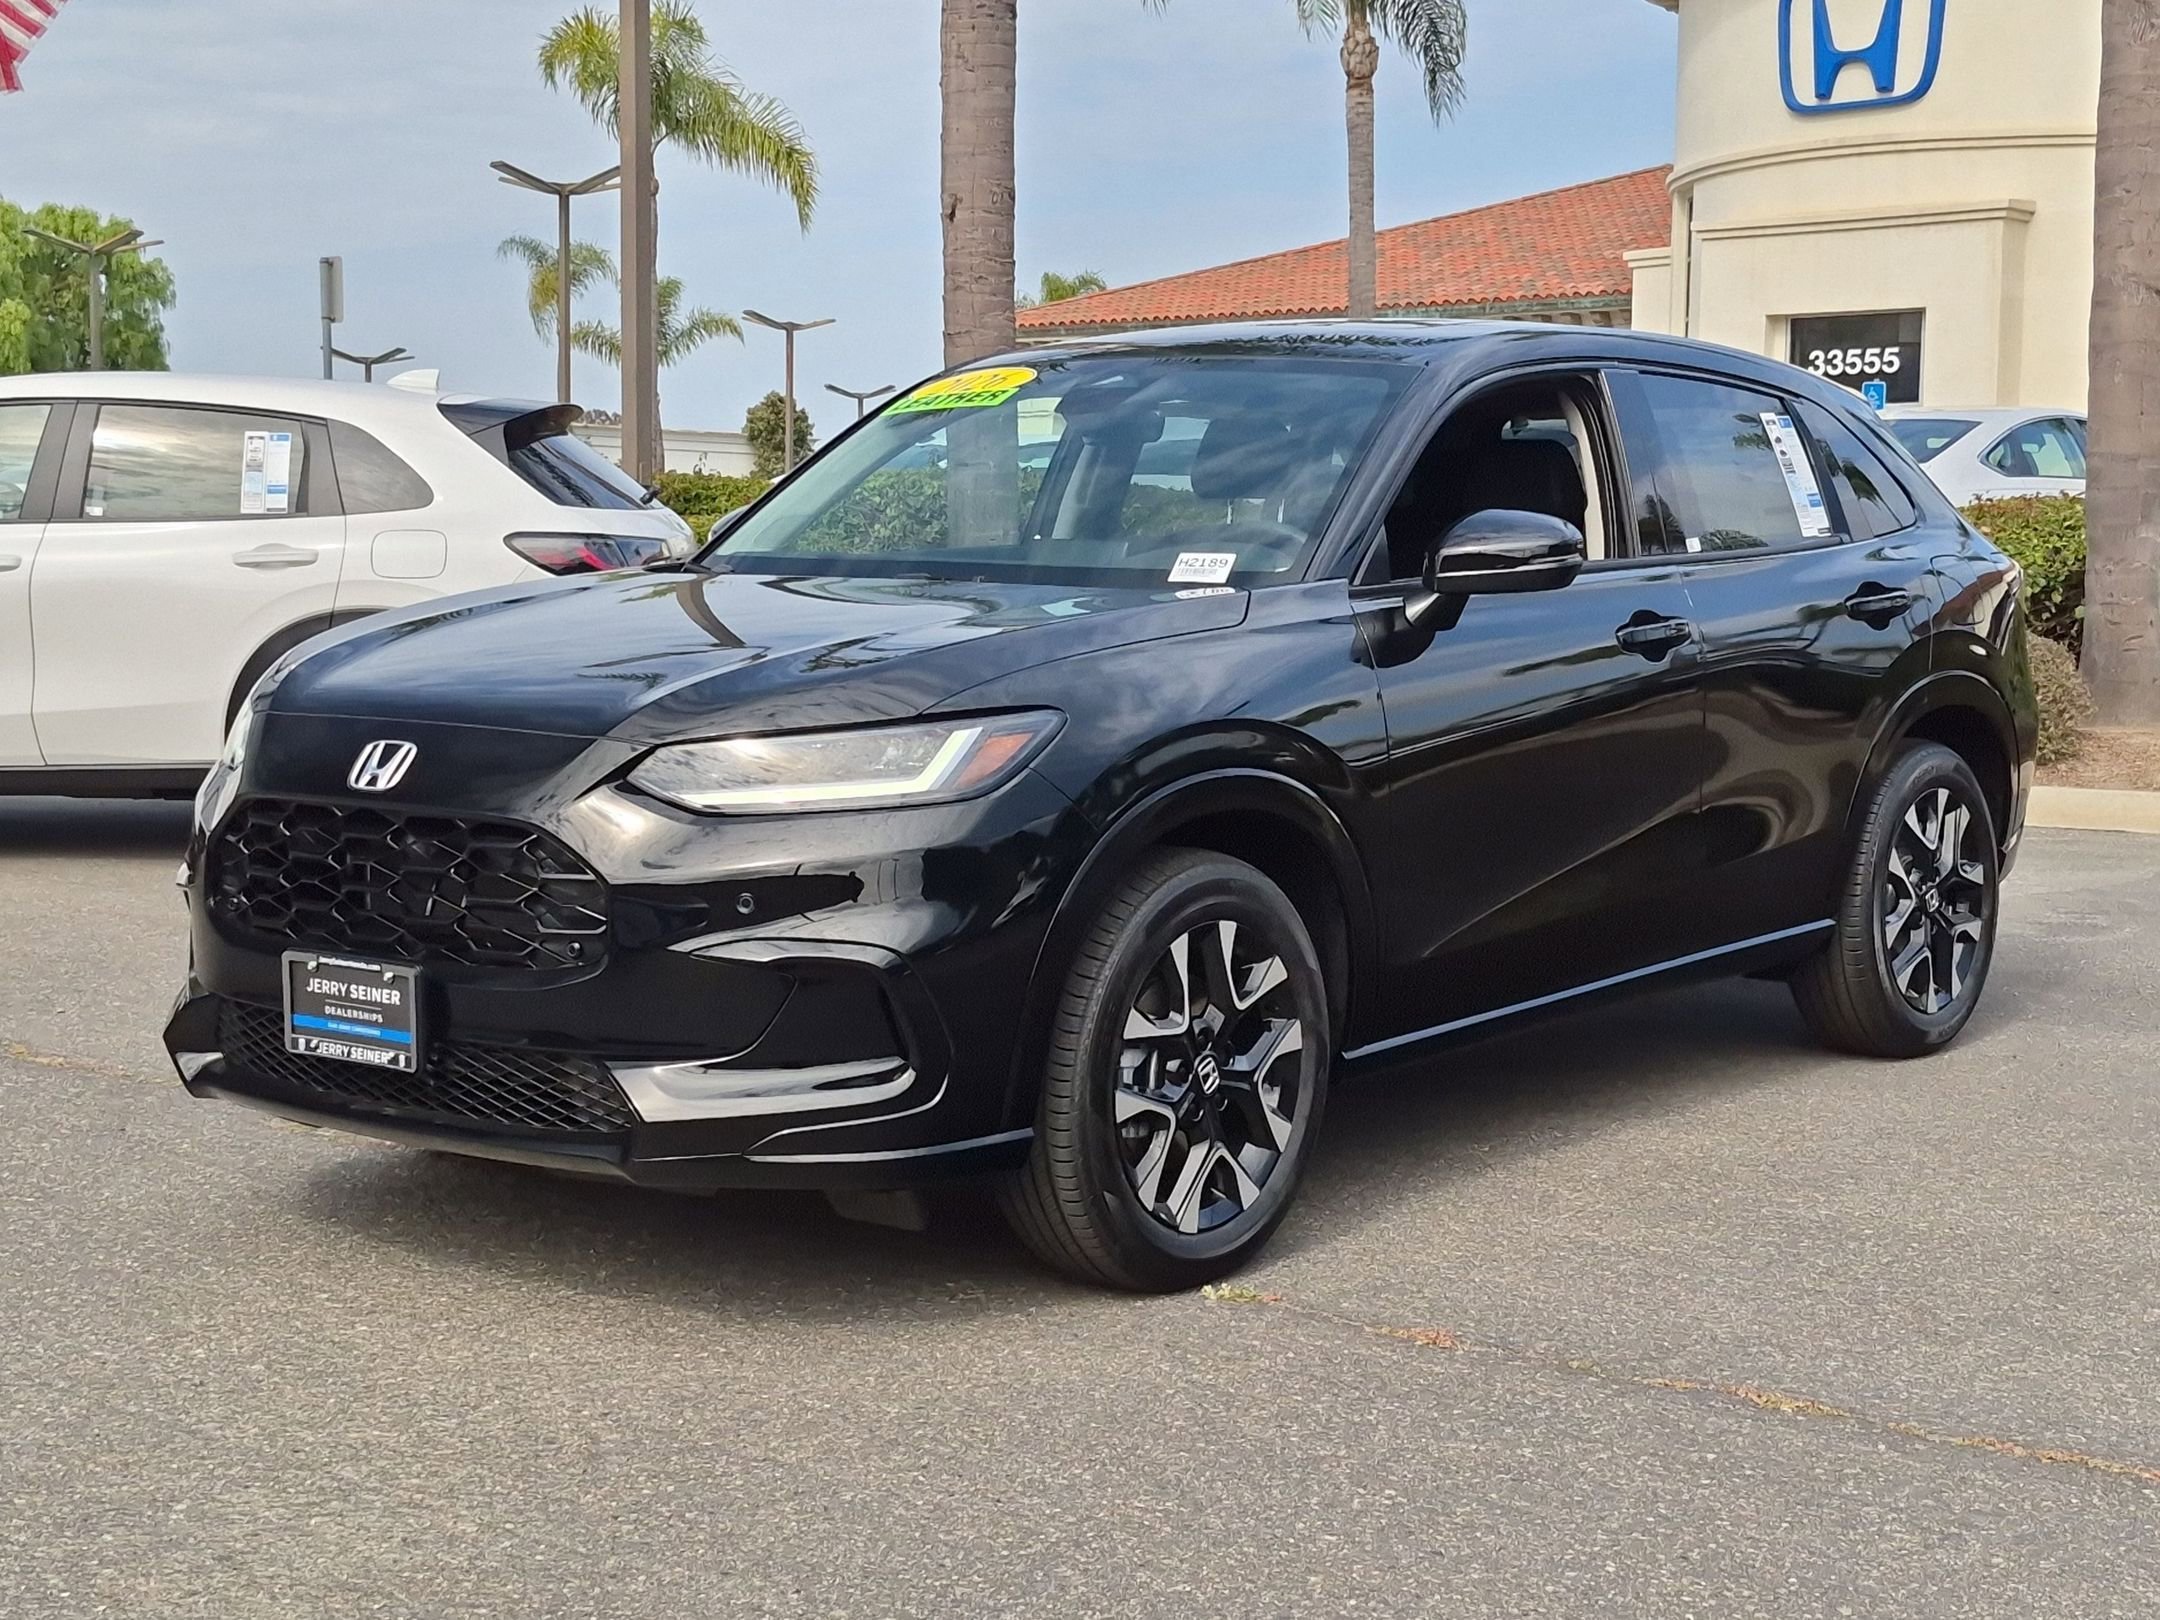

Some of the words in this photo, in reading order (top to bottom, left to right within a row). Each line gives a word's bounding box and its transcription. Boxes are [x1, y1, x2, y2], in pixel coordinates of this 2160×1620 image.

[1807, 347, 1900, 376] 33555
[890, 389, 1010, 412] LEATHER
[1178, 558, 1229, 569] H2189
[306, 978, 348, 997] JERRY
[350, 984, 401, 1005] SEINER
[324, 1006, 384, 1023] DEALERSHIPS
[316, 1040, 350, 1057] JERRY
[350, 1047, 389, 1064] SEINER
